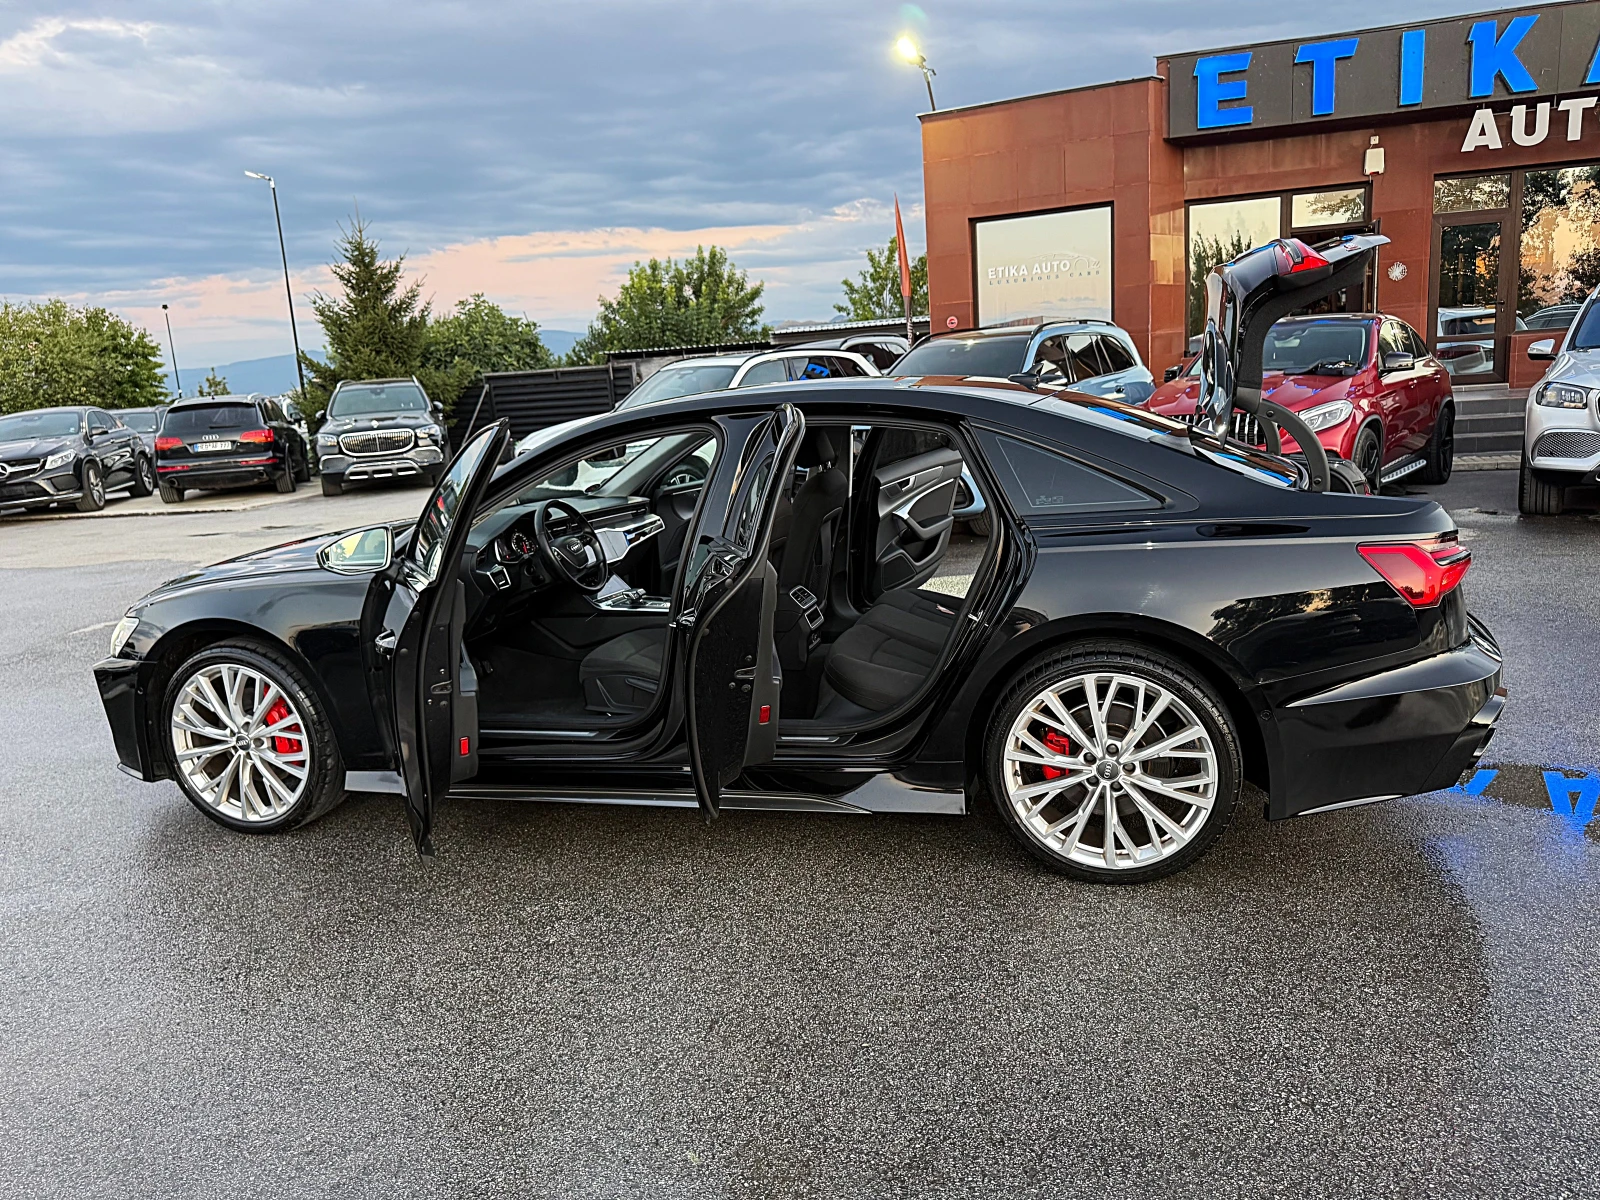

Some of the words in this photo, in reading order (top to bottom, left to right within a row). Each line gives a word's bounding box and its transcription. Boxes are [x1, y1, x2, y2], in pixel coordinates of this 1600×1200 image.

[987, 264, 1029, 280] ETIKA
[1032, 259, 1071, 275] AUTO
[989, 274, 1060, 286] LUXURIOUS
